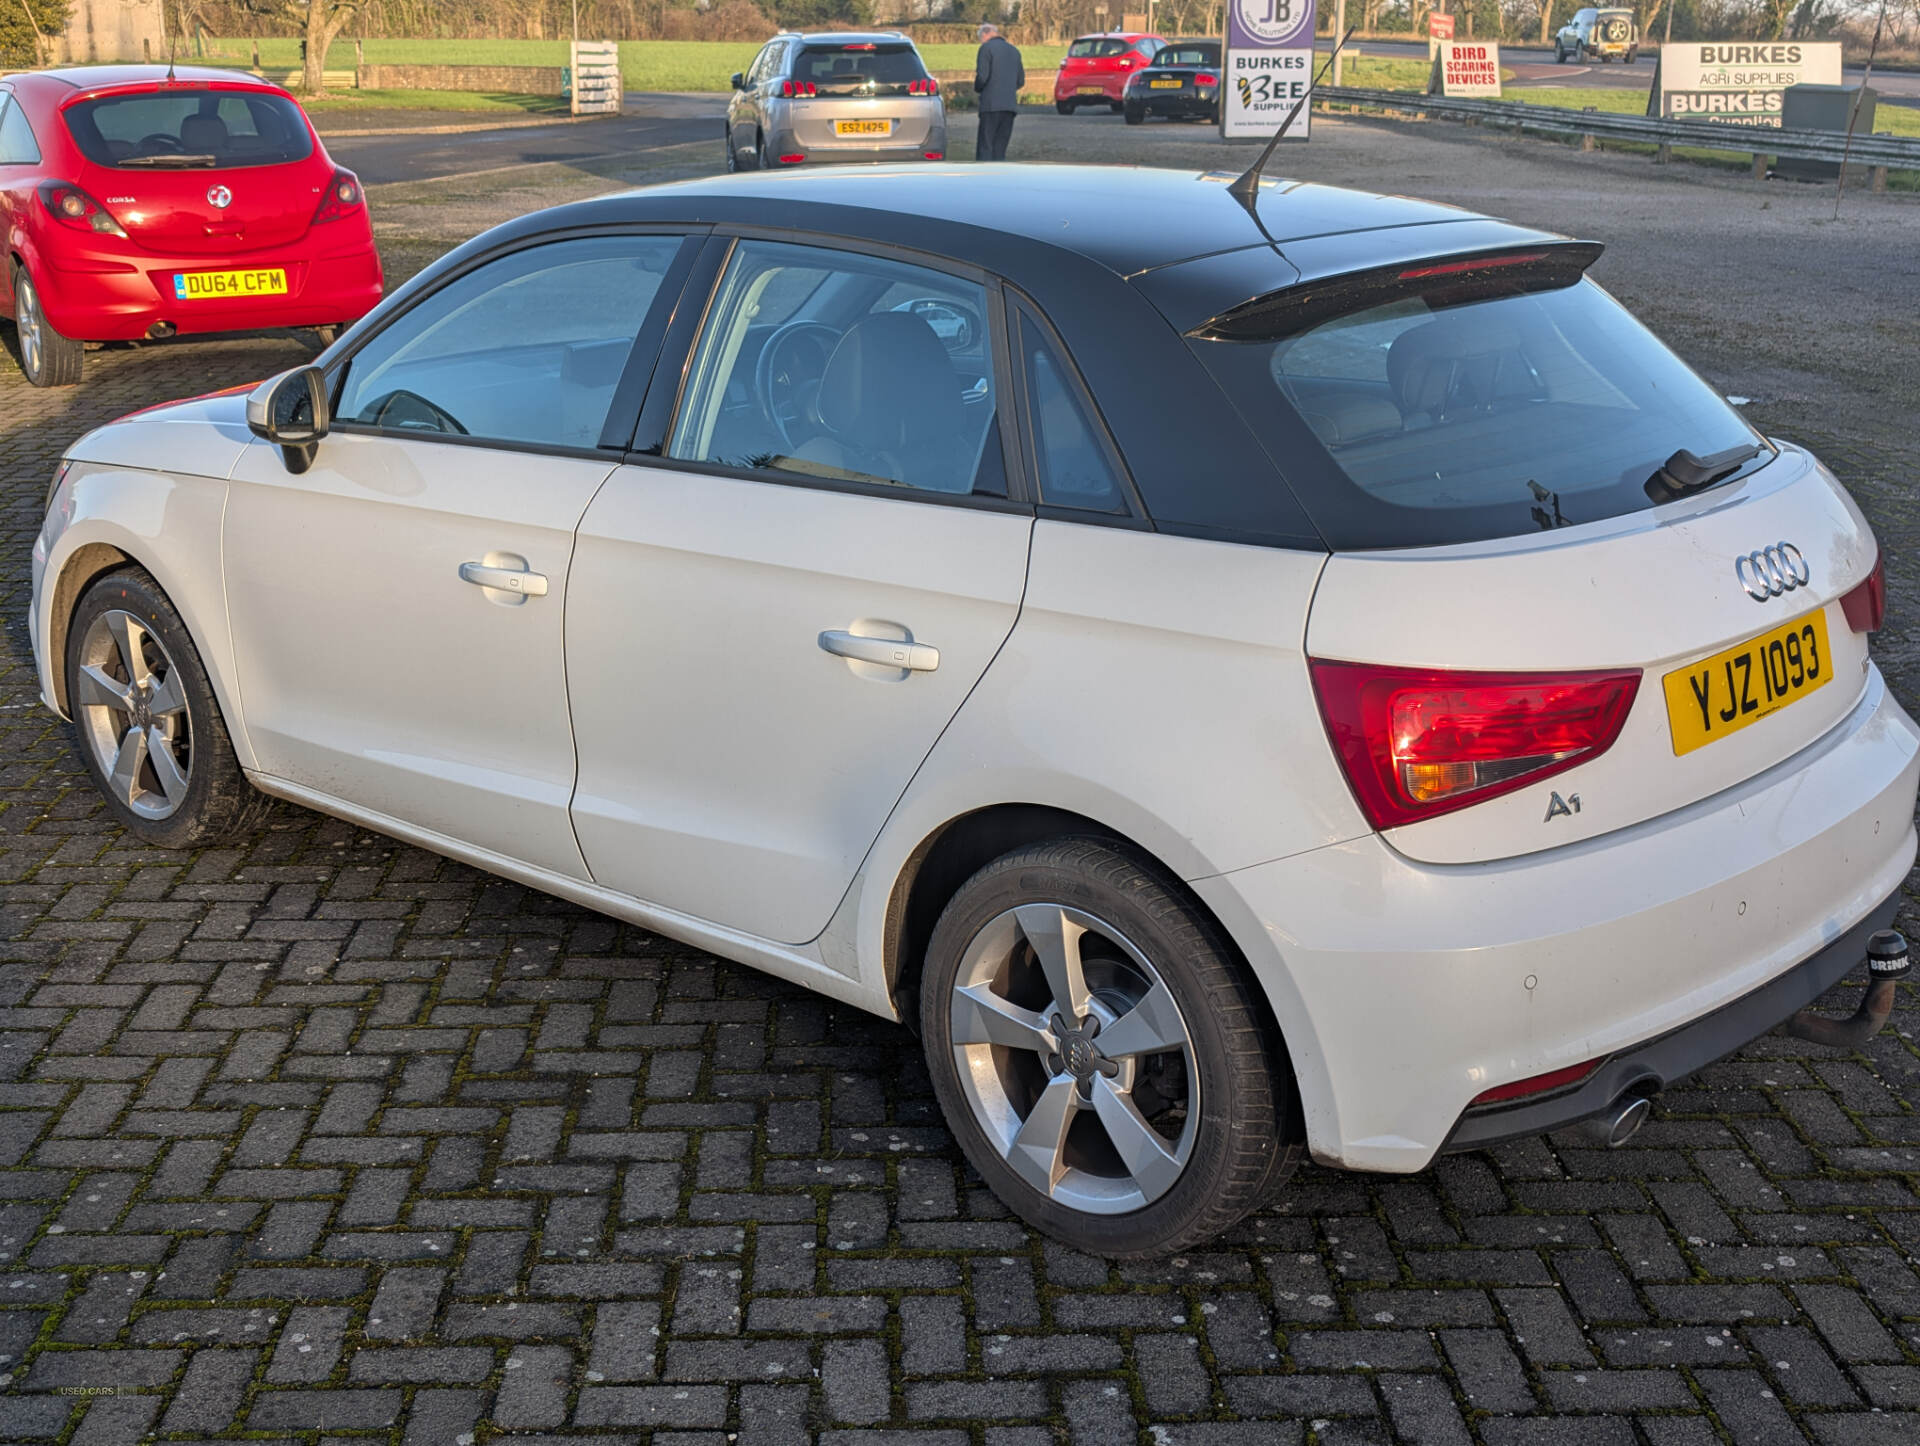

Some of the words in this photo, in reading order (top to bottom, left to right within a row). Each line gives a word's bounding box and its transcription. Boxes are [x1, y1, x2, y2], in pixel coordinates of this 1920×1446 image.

[1257, 23, 1293, 36] SOLUTIONS
[1452, 47, 1486, 60] BIRD
[1700, 46, 1802, 64] BURKES
[1236, 57, 1305, 69] BURKES
[1446, 61, 1495, 72] SCARING
[1447, 73, 1496, 85] DEVICES
[1699, 73, 1730, 85] AGRI
[1734, 72, 1795, 85] SUPPLIES
[1249, 74, 1304, 102] BEE
[1253, 103, 1297, 111] SUPPLIE
[1670, 93, 1782, 113] BURKES
[842, 123, 860, 133] ESZ
[188, 274, 239, 294] DU64
[244, 271, 283, 292] CFM
[1690, 652, 1759, 732] YJZ
[1759, 624, 1820, 703] 1093
[1543, 791, 1582, 824] A1
